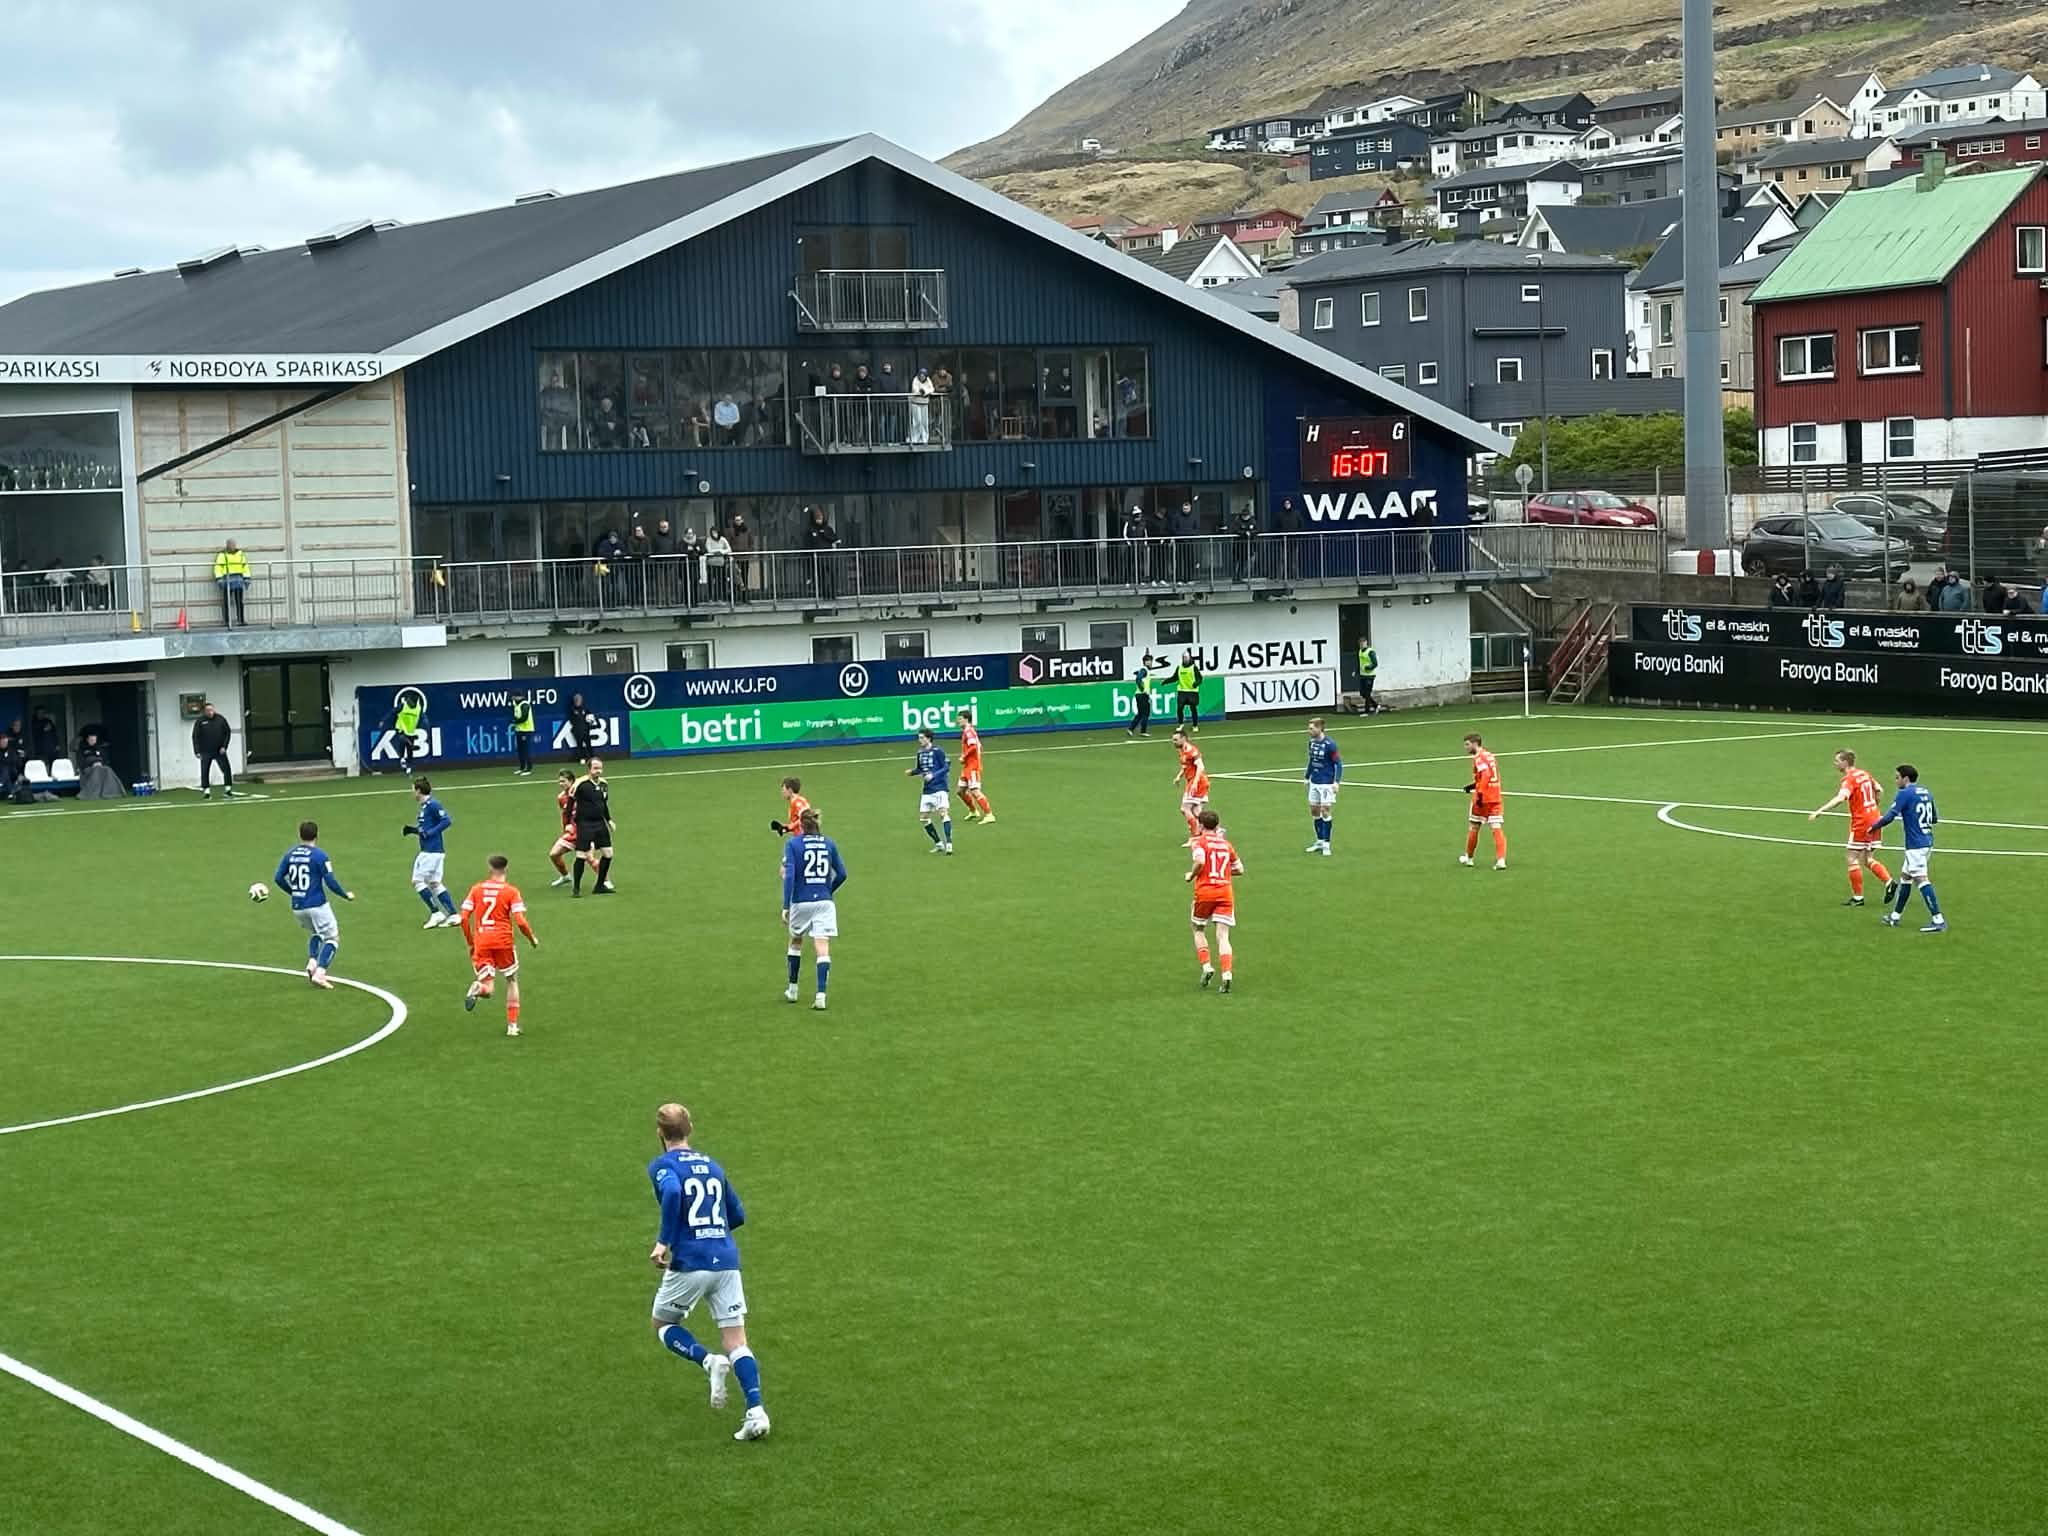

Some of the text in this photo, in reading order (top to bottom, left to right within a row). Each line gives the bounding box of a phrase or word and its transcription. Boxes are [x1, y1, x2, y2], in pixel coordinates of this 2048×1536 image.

[170, 360, 382, 377] NORÐOYA SPARIKASSI
[1306, 425, 1320, 442] H
[1392, 422, 1405, 440] G
[1332, 451, 1388, 477] 16:07
[1717, 620, 1727, 631] &
[1728, 621, 1770, 633] maskin
[1862, 625, 1872, 637] &
[1874, 626, 1920, 639] maskin
[2021, 631, 2032, 643] &
[1228, 639, 1327, 670] ASFALT
[1635, 652, 1724, 676] Føroya Banki
[897, 666, 984, 685] WWW.KJ.FO
[1050, 656, 1114, 679] Frakta
[1780, 659, 1879, 684] Føroya Banki
[630, 683, 649, 699] KJ
[686, 677, 777, 696] WWW.KJ.FO
[845, 672, 863, 688] KJ
[1940, 668, 2048, 694] Føroya Banki
[460, 689, 558, 709] WWW.J.FO
[1113, 687, 1176, 717] btr
[681, 708, 761, 745] betri
[466, 723, 518, 755] kbi.f
[803, 850, 830, 877] 25
[1208, 850, 1231, 879] 17
[288, 864, 311, 891] 26
[481, 897, 497, 925] 2
[684, 1177, 726, 1227] 22
